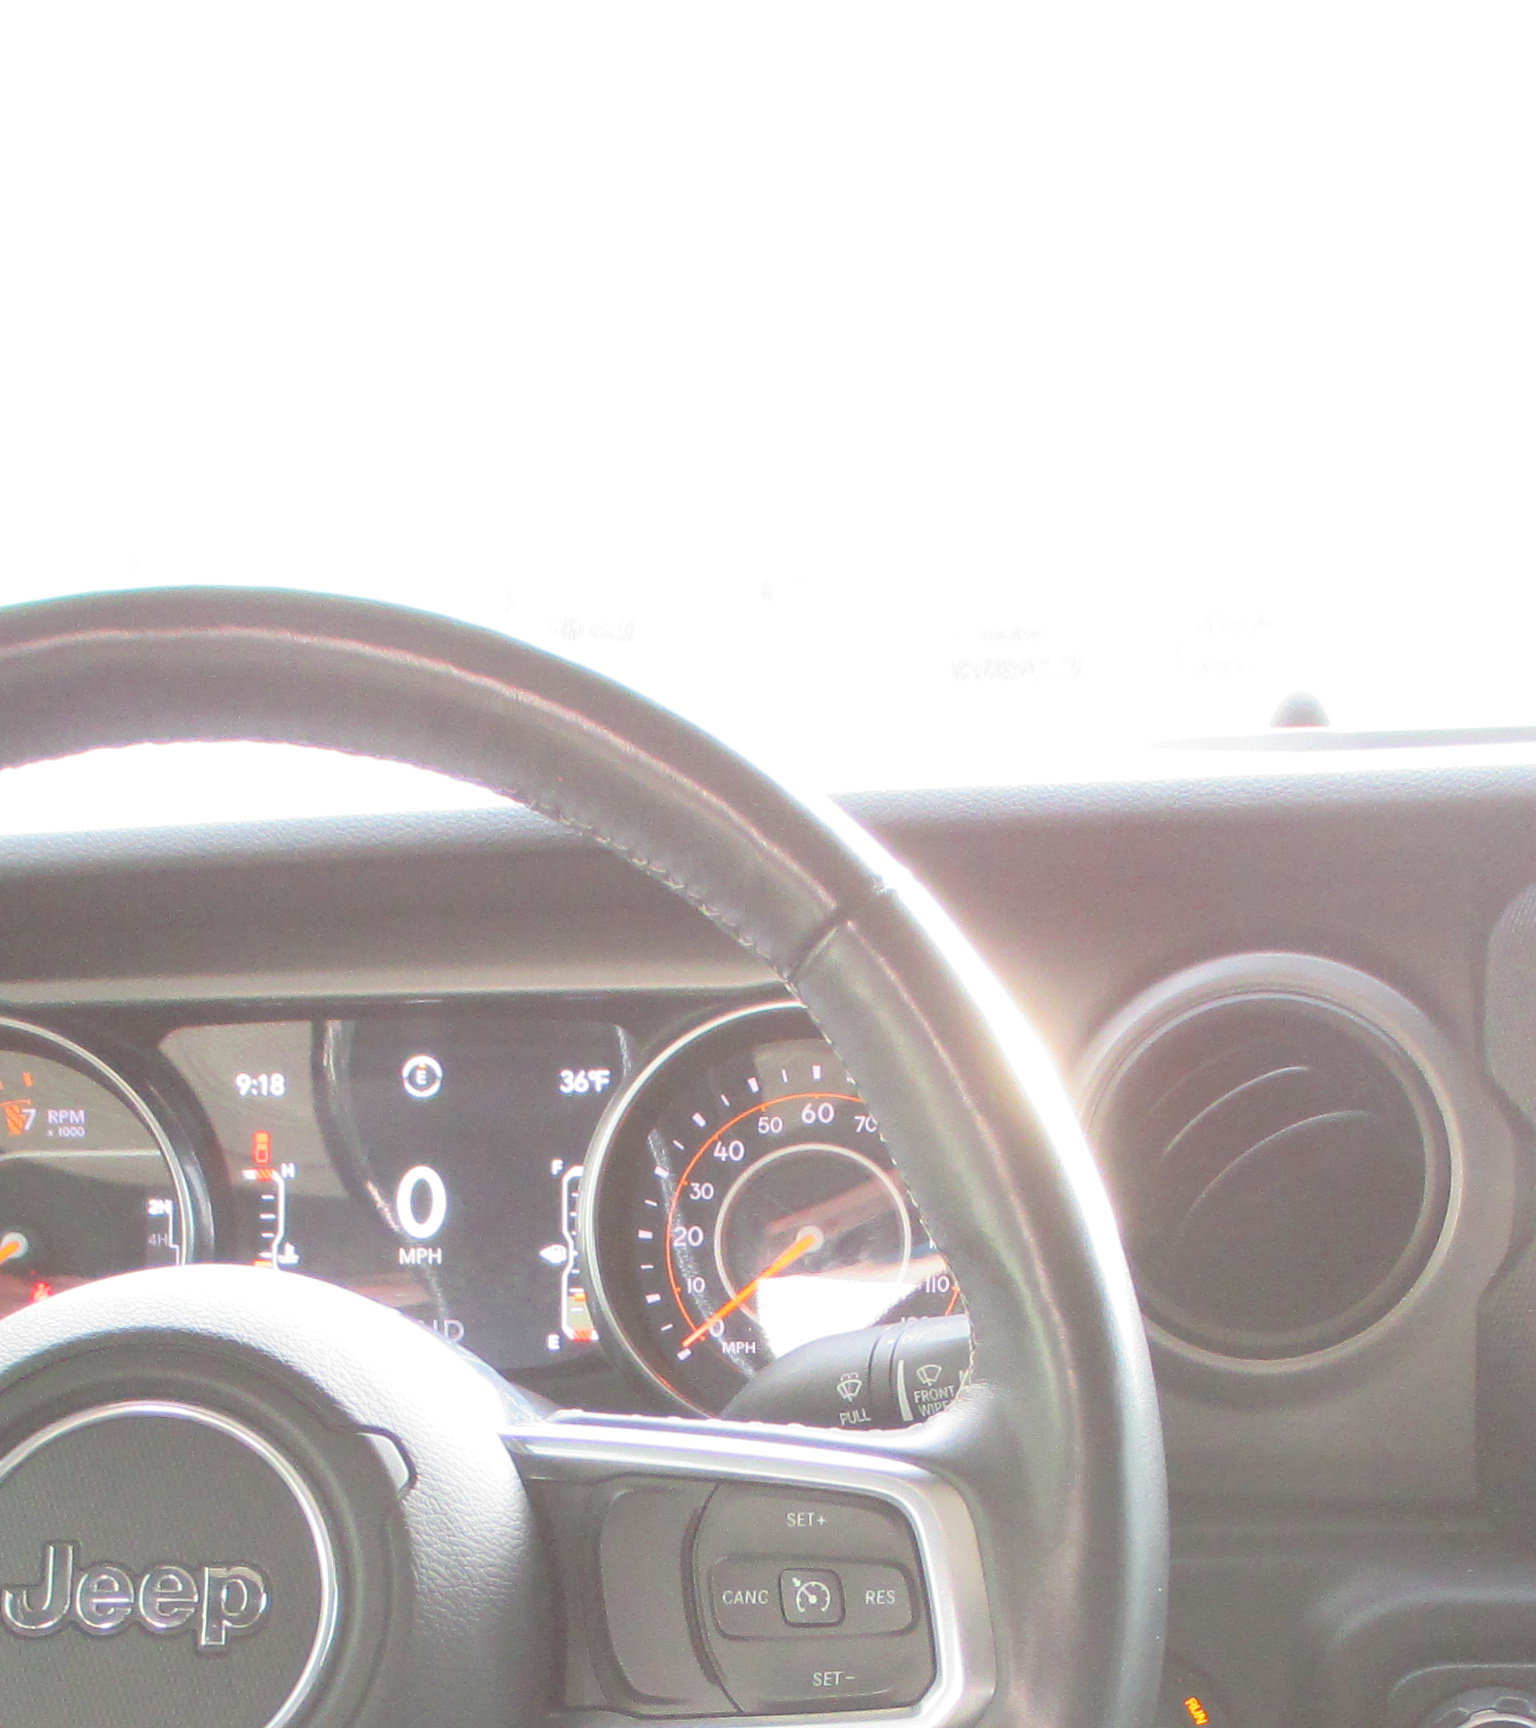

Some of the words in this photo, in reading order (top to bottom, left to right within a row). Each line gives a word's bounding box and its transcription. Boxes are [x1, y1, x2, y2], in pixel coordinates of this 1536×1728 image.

[235, 1073, 286, 1097] 9:18
[559, 1070, 611, 1094] 36°F
[21, 1108, 38, 1131] 7
[47, 1109, 85, 1124] RPM
[801, 1104, 834, 1125] 60
[58, 1126, 85, 1138] 1000
[758, 1116, 783, 1134] 50
[714, 1141, 745, 1162] 40
[281, 1163, 296, 1180] H
[552, 1160, 563, 1176] F
[690, 1182, 714, 1201] 30
[397, 1165, 447, 1240] 0
[147, 1233, 169, 1248] 4H
[673, 1227, 704, 1248] 20
[398, 1247, 443, 1267] MPH
[686, 1278, 706, 1295] 10
[548, 1335, 560, 1351] E
[722, 1340, 756, 1355] MPH
[914, 1385, 955, 1403] FRONT
[839, 1408, 871, 1425] PULL
[2, 1542, 270, 1650] Jeep
[722, 1590, 769, 1605] CANC
[866, 1590, 896, 1605] RES
[1184, 1697, 1210, 1726] RUN
